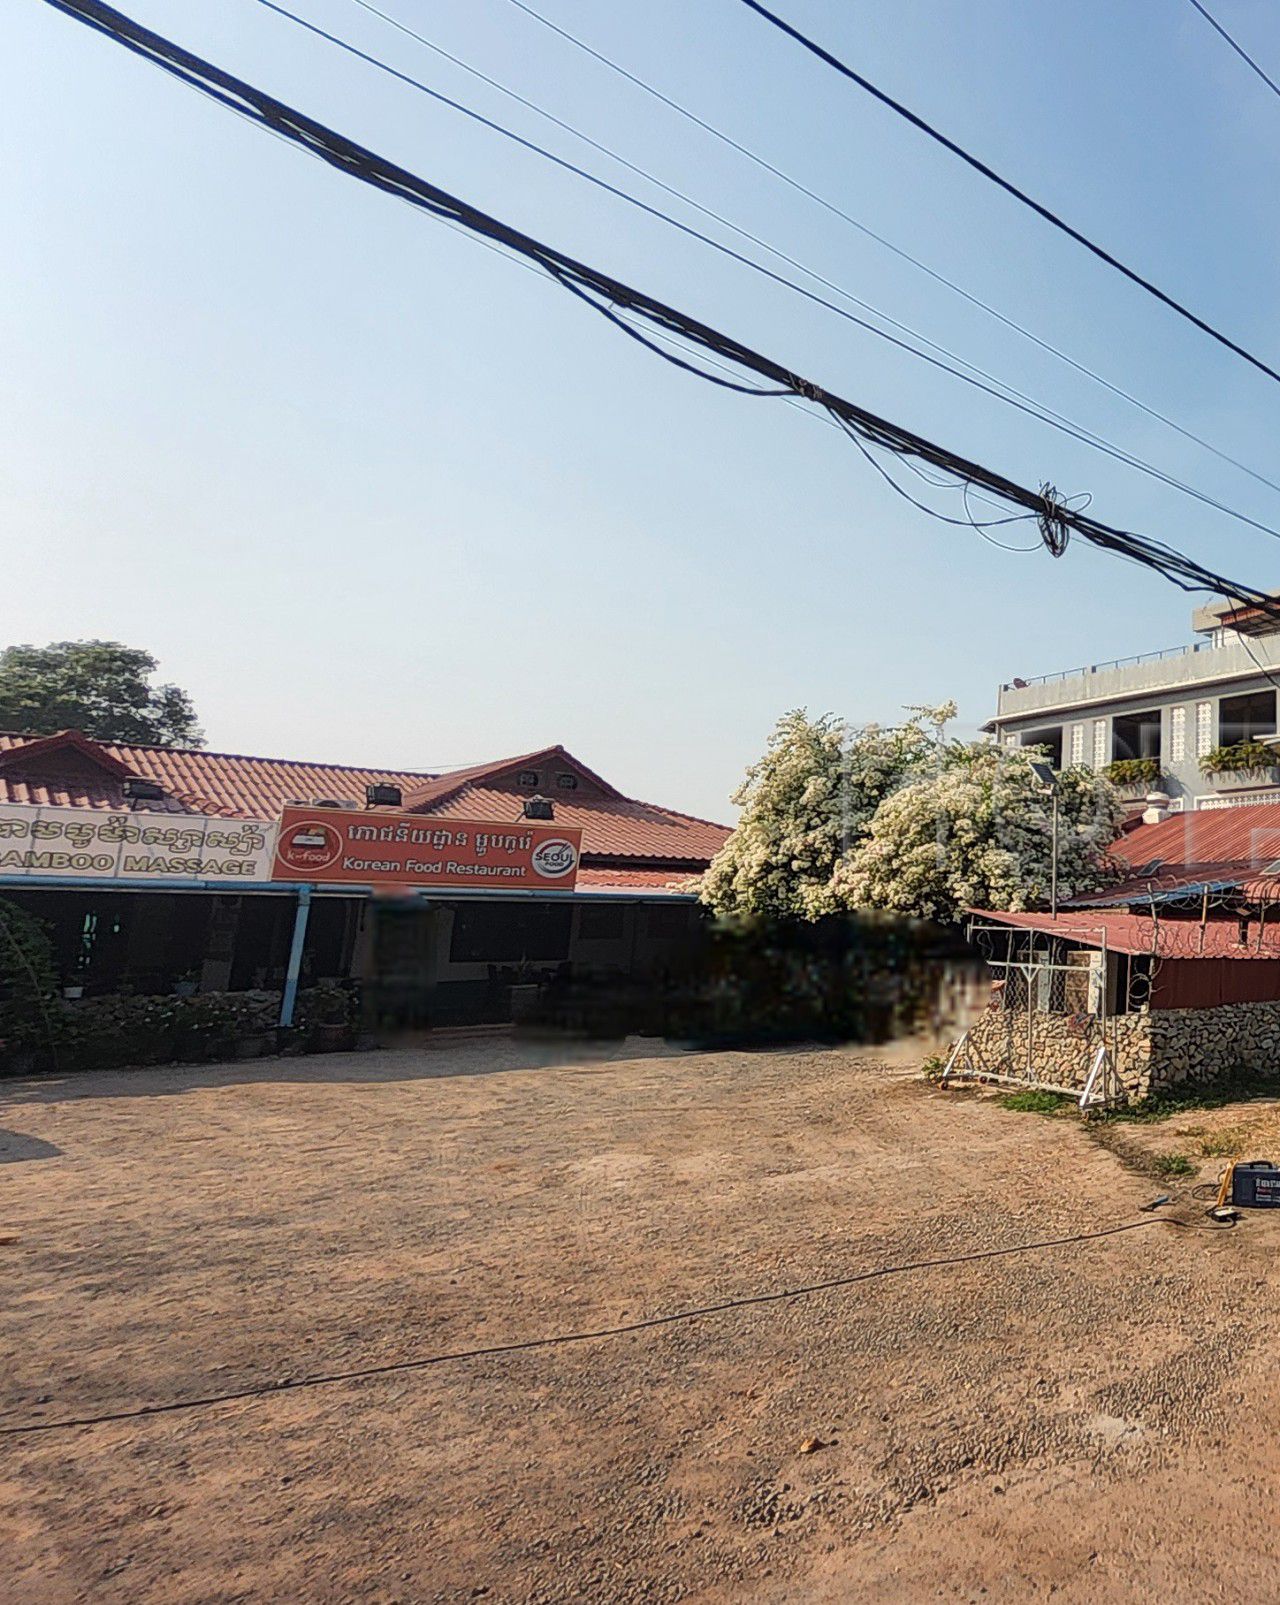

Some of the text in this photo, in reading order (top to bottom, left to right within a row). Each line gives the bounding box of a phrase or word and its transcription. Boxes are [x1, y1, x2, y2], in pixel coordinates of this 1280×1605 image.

[0, 815, 265, 856] ាមបូម៉ាស្សាស្ប៉ា
[0, 850, 257, 876] AMBOO MASSAGE
[343, 857, 527, 877] Korean Food Restaurant
[535, 851, 575, 865] SEOUL
